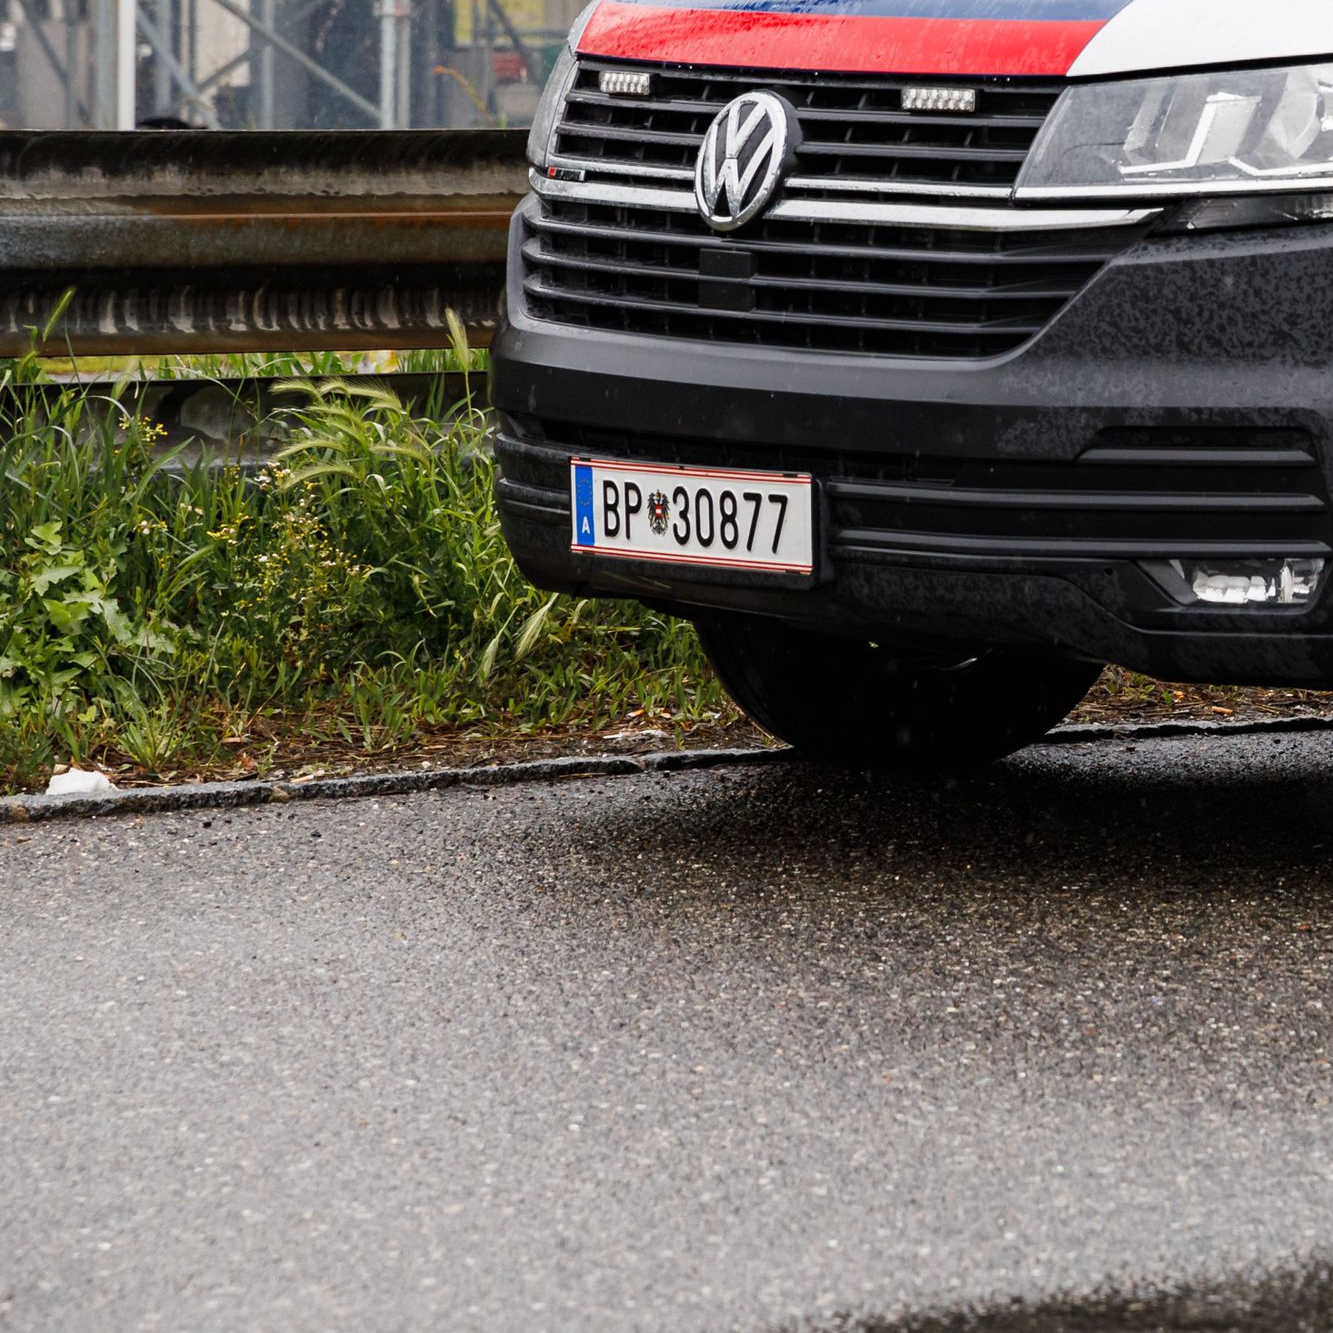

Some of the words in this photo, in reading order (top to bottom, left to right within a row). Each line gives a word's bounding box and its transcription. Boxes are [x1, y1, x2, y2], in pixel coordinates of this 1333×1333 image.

[696, 92, 787, 227] VW
[581, 516, 591, 535] A
[602, 479, 643, 540] BP
[671, 485, 789, 555] 30877
